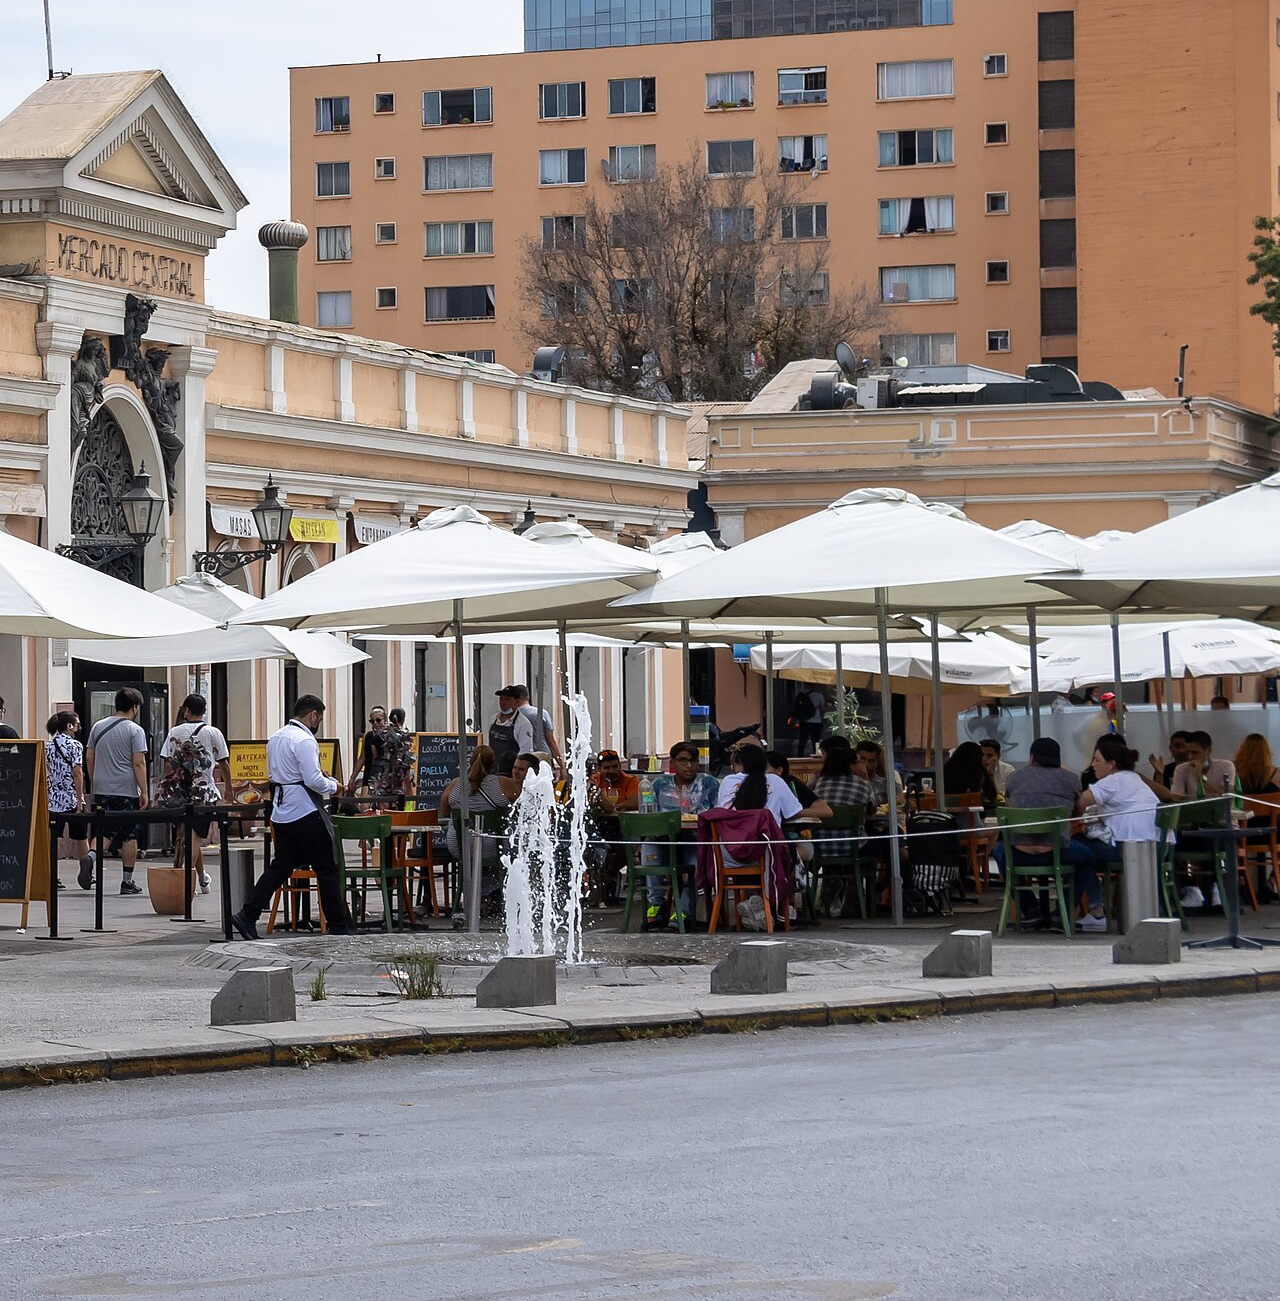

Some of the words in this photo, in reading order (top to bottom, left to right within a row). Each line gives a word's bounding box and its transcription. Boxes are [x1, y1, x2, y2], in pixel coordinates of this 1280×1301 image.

[58, 233, 129, 282] MERCADO
[132, 250, 196, 297] CENTRAL
[229, 516, 252, 537] MASAS
[422, 745, 441, 754] LOCOS
[420, 766, 449, 776] PAELLA
